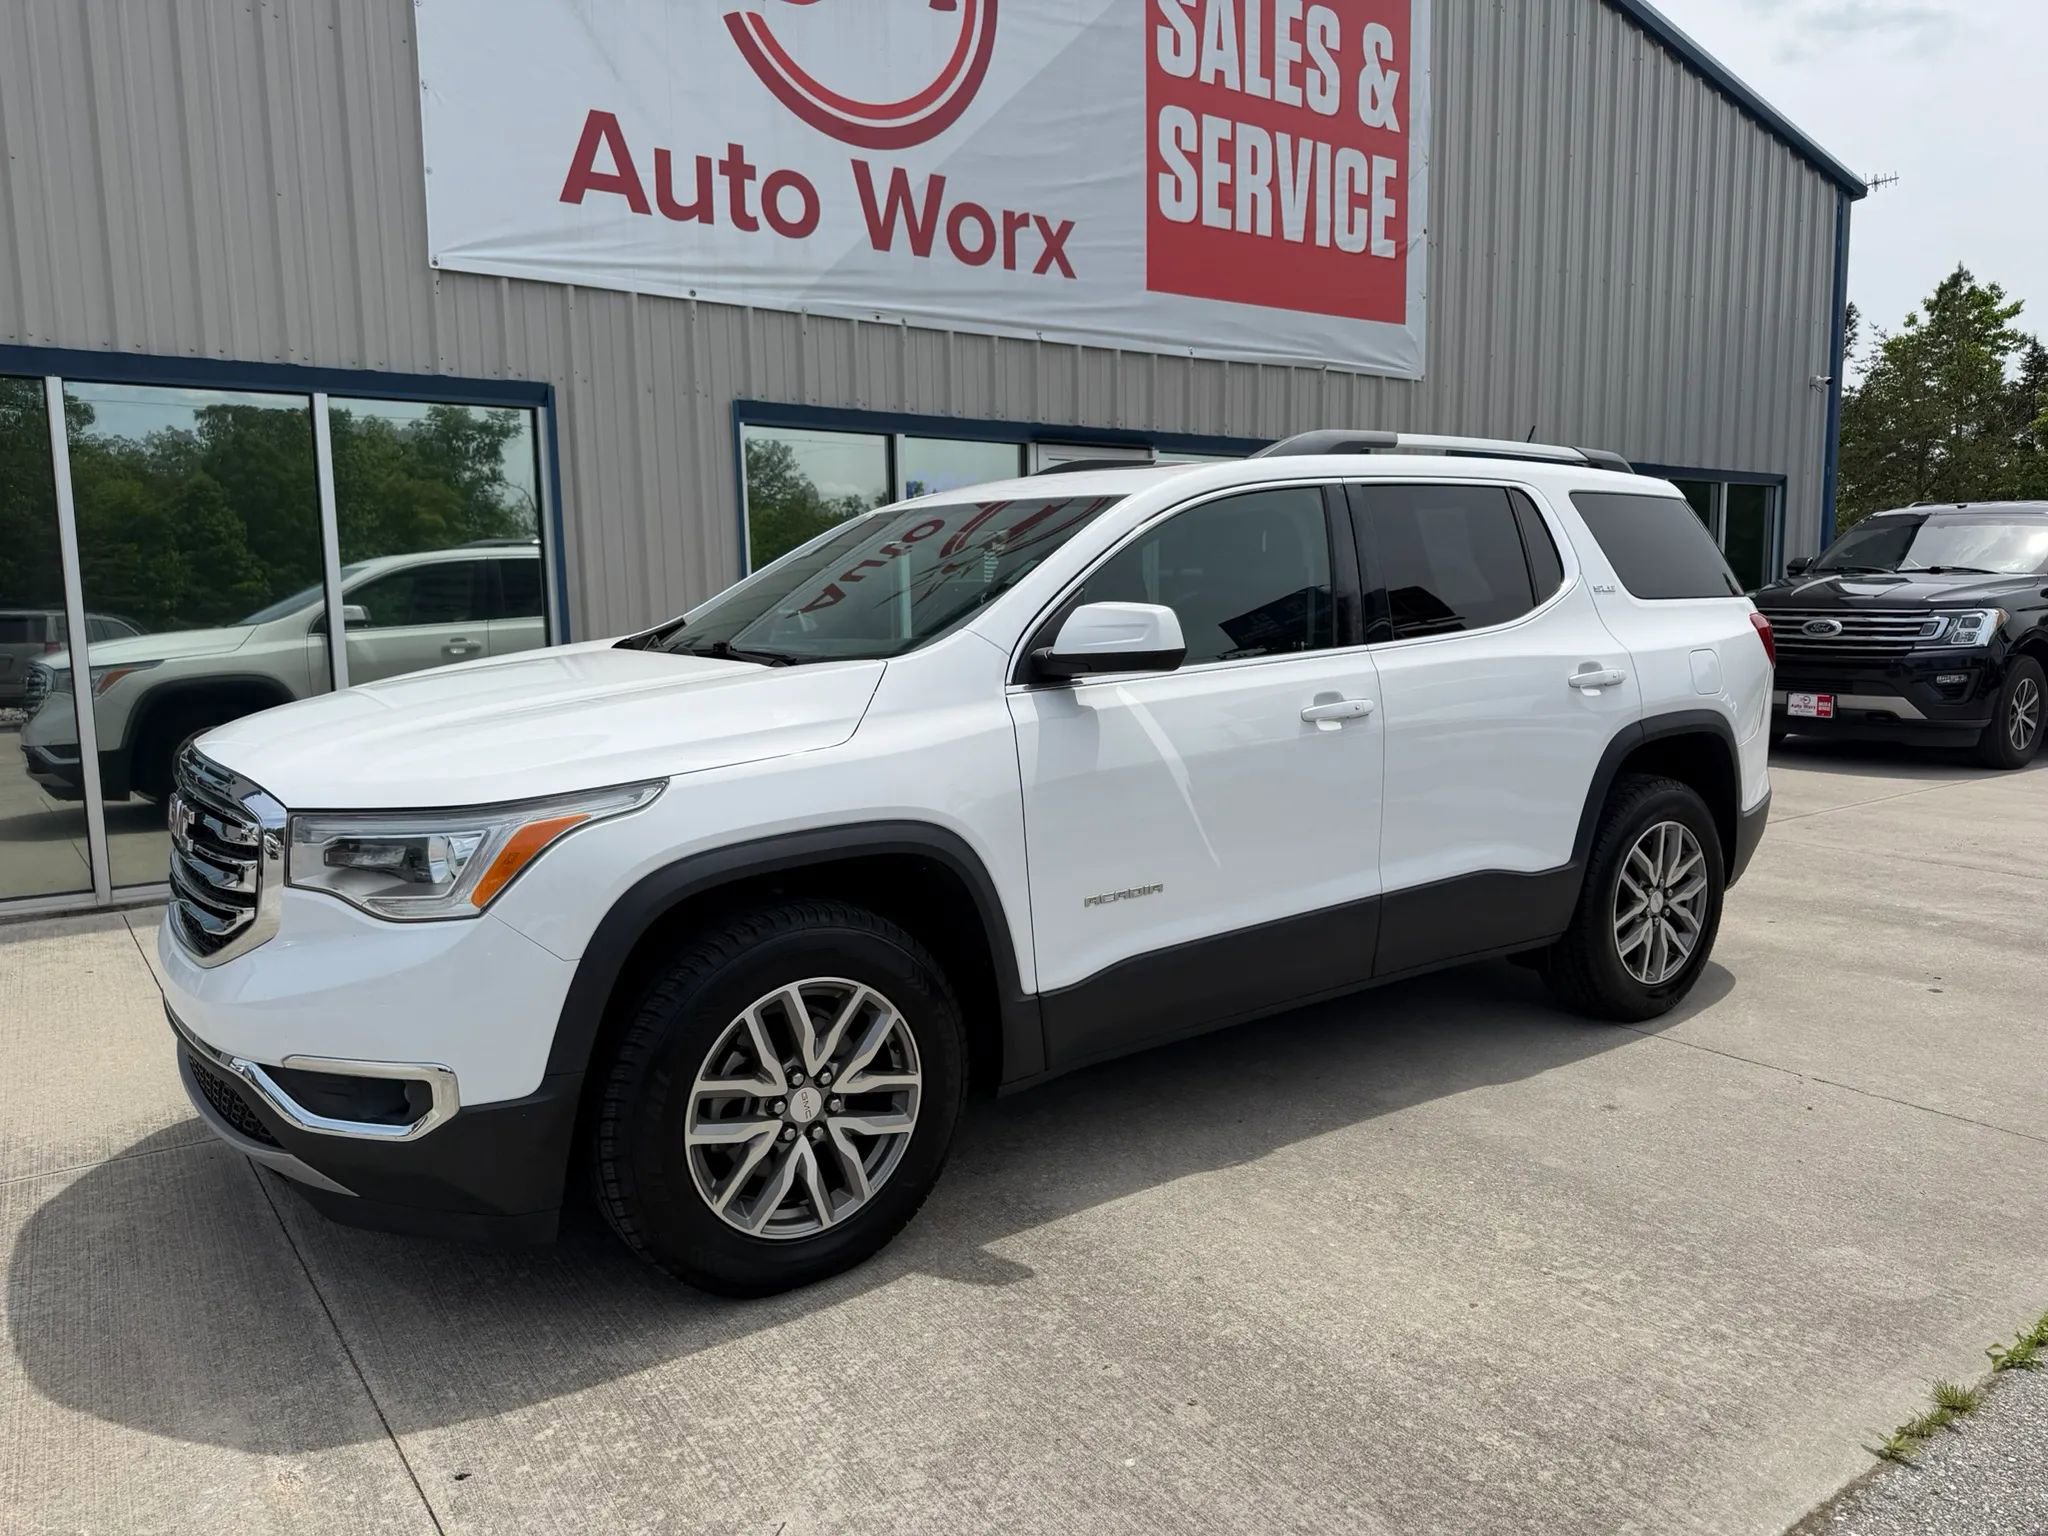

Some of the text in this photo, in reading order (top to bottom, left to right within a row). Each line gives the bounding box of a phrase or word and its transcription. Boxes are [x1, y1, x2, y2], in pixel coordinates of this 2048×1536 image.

[1157, 0, 1400, 133] SALES &
[559, 109, 1077, 279] Auto Worx
[1158, 104, 1397, 259] SERVICE
[168, 793, 196, 852] MC
[1084, 883, 1164, 908] ACADIA
[801, 1091, 812, 1120] GMC
